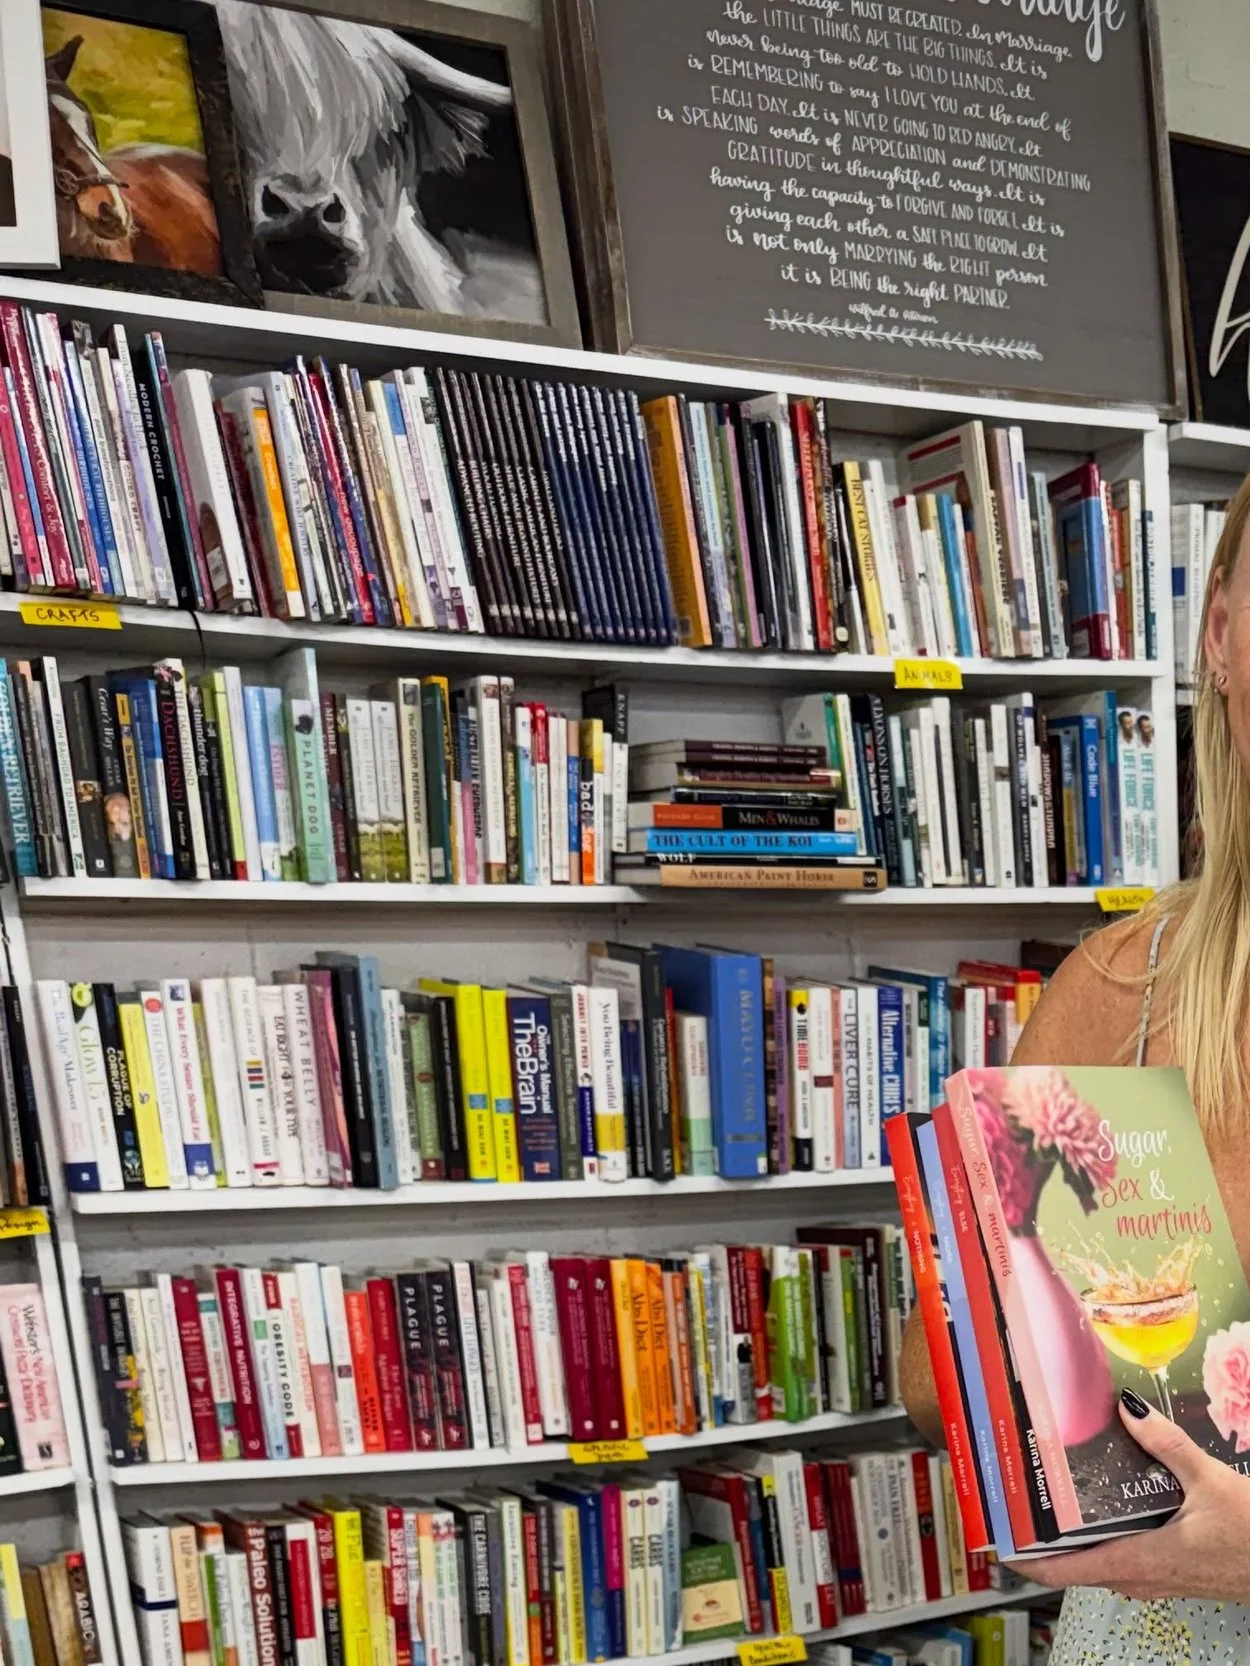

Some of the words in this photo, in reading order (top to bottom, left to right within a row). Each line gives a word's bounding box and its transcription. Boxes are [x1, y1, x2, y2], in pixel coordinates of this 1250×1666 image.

[688, 54, 704, 70] is
[711, 54, 823, 91] REMEMBERING
[828, 81, 845, 94] to
[850, 89, 879, 108] say
[884, 86, 890, 102] I
[895, 88, 927, 110] LOVE
[931, 94, 958, 114] YOU
[963, 103, 984, 119] at
[989, 104, 1015, 125] the
[1016, 112, 1050, 130] end
[1056, 119, 1072, 141] of
[657, 105, 674, 122] is
[682, 106, 758, 135] SPEAKING
[769, 126, 820, 145] words
[825, 132, 842, 155] of
[852, 135, 946, 166] APPRECIATION
[952, 155, 986, 172] and
[990, 158, 1091, 192] DEMONSTRATING
[726, 225, 744, 245] is
[753, 231, 789, 250] not
[794, 238, 839, 265] only
[844, 241, 917, 268] MARRYING
[922, 253, 946, 272] the
[950, 255, 991, 277] RIGHT
[996, 268, 1049, 287] person
[781, 263, 799, 282] it
[805, 268, 822, 285] is
[830, 267, 871, 291] BEING
[877, 276, 900, 295] the
[904, 281, 949, 309] right
[953, 285, 1010, 310] PARTNER.
[138, 382, 158, 422] MODERN
[146, 427, 165, 480] CROCHET
[34, 606, 101, 624] CRAFTS
[903, 666, 954, 684] ANIMALS
[161, 701, 184, 806] DACHSHUND
[303, 740, 316, 791] PLANET
[1086, 745, 1098, 774] Code
[1087, 775, 1098, 798] Blue
[308, 797, 320, 836] DOG
[655, 835, 679, 847] THE
[689, 835, 725, 847] CULT
[731, 835, 748, 847] OF
[756, 835, 778, 847] THE
[788, 836, 812, 847] KOI
[689, 868, 751, 881] AMERICAN
[756, 869, 793, 881] PAINT
[796, 869, 834, 882] HORSE
[296, 991, 311, 1048] WHEAT
[844, 1012, 857, 1062] LIVER
[881, 1009, 900, 1071] Alternative
[537, 1025, 548, 1073] Owner's
[301, 1056, 317, 1106] BELLY
[540, 1075, 553, 1114] Manual
[846, 1066, 859, 1113] CURE
[882, 1075, 900, 1113] CURES
[1101, 1172, 1143, 1210] Sex
[1148, 1167, 1175, 1202] &
[958, 1211, 969, 1233] ELSE
[973, 1161, 988, 1190] Sex
[988, 1212, 1013, 1277] martinis
[1115, 1202, 1213, 1241] martinis
[912, 1230, 927, 1274] NOTHING
[405, 1287, 421, 1349] PLAGUE
[433, 1284, 449, 1347] PLAGUE
[950, 1423, 961, 1455] Karina
[958, 1458, 971, 1496] Morrell
[998, 1420, 1008, 1453] Karina
[1005, 1455, 1018, 1495] Morrell
[1026, 1428, 1041, 1468] Karina
[1035, 1469, 1052, 1510] Morrell
[1120, 1474, 1180, 1501] KARINA
[249, 1535, 266, 1589] Paleo
